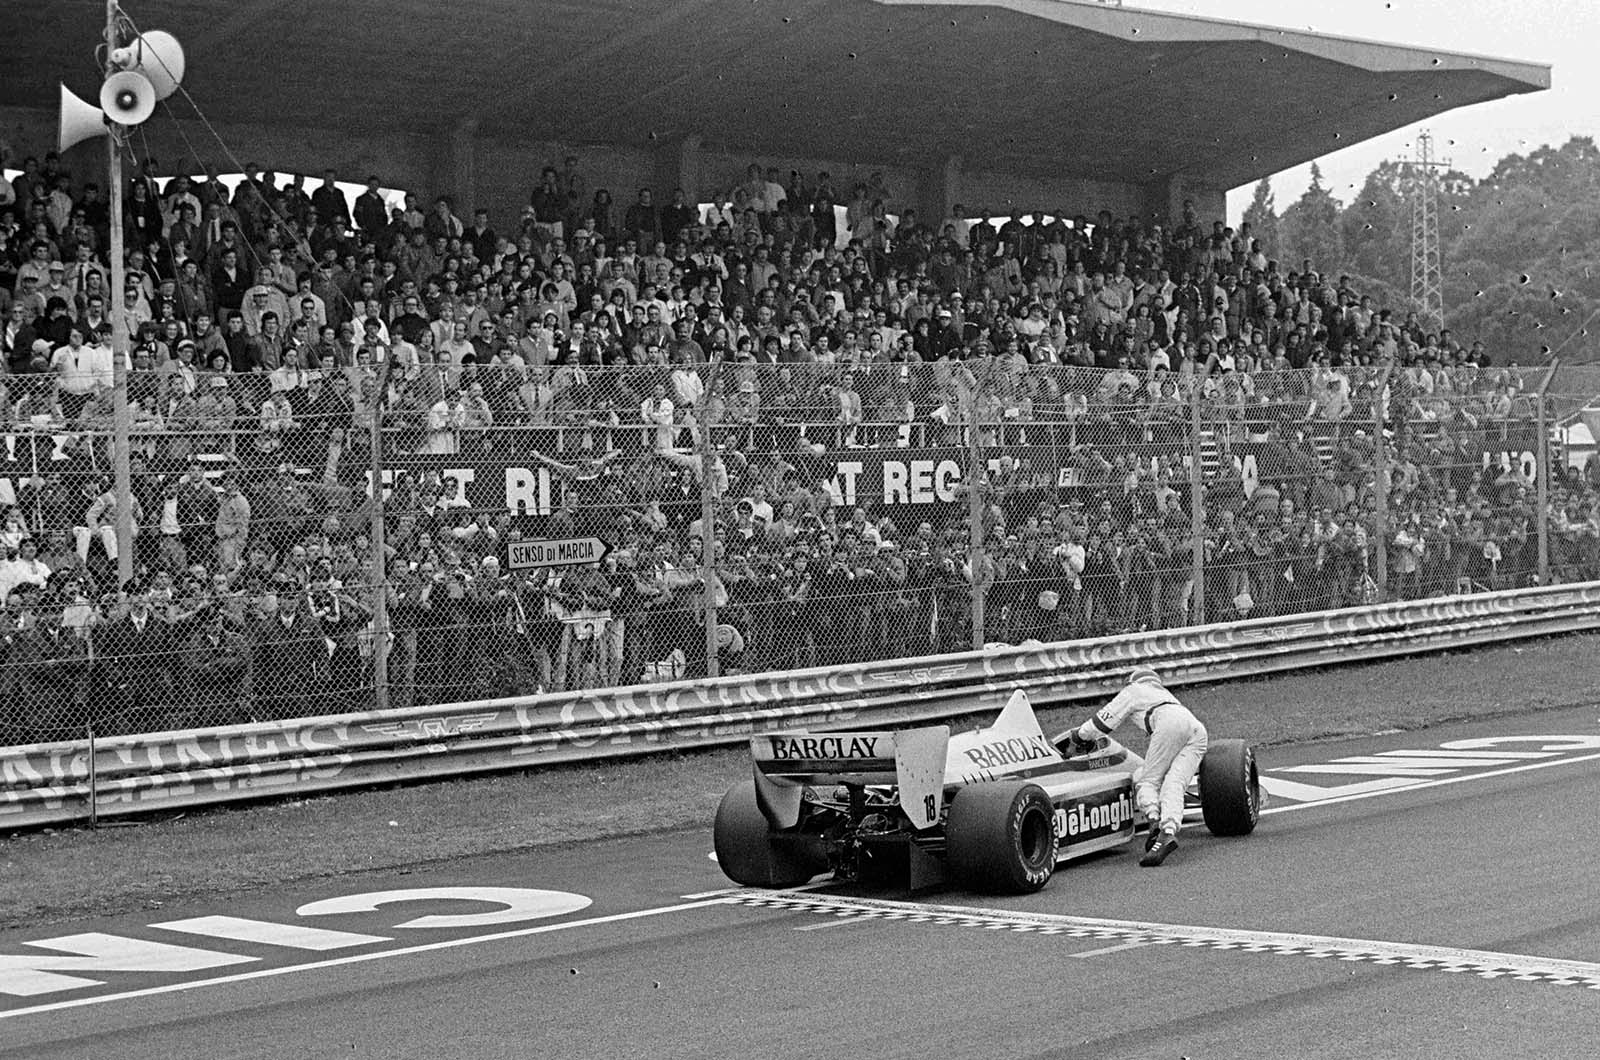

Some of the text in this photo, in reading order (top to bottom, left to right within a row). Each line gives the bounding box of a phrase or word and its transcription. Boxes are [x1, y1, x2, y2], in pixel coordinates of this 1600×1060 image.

[513, 546, 544, 564] SENSO
[559, 542, 594, 561] MARCIA
[771, 737, 879, 759] BARCLAY
[963, 735, 1052, 769] BARCLAY
[924, 794, 937, 822] 18
